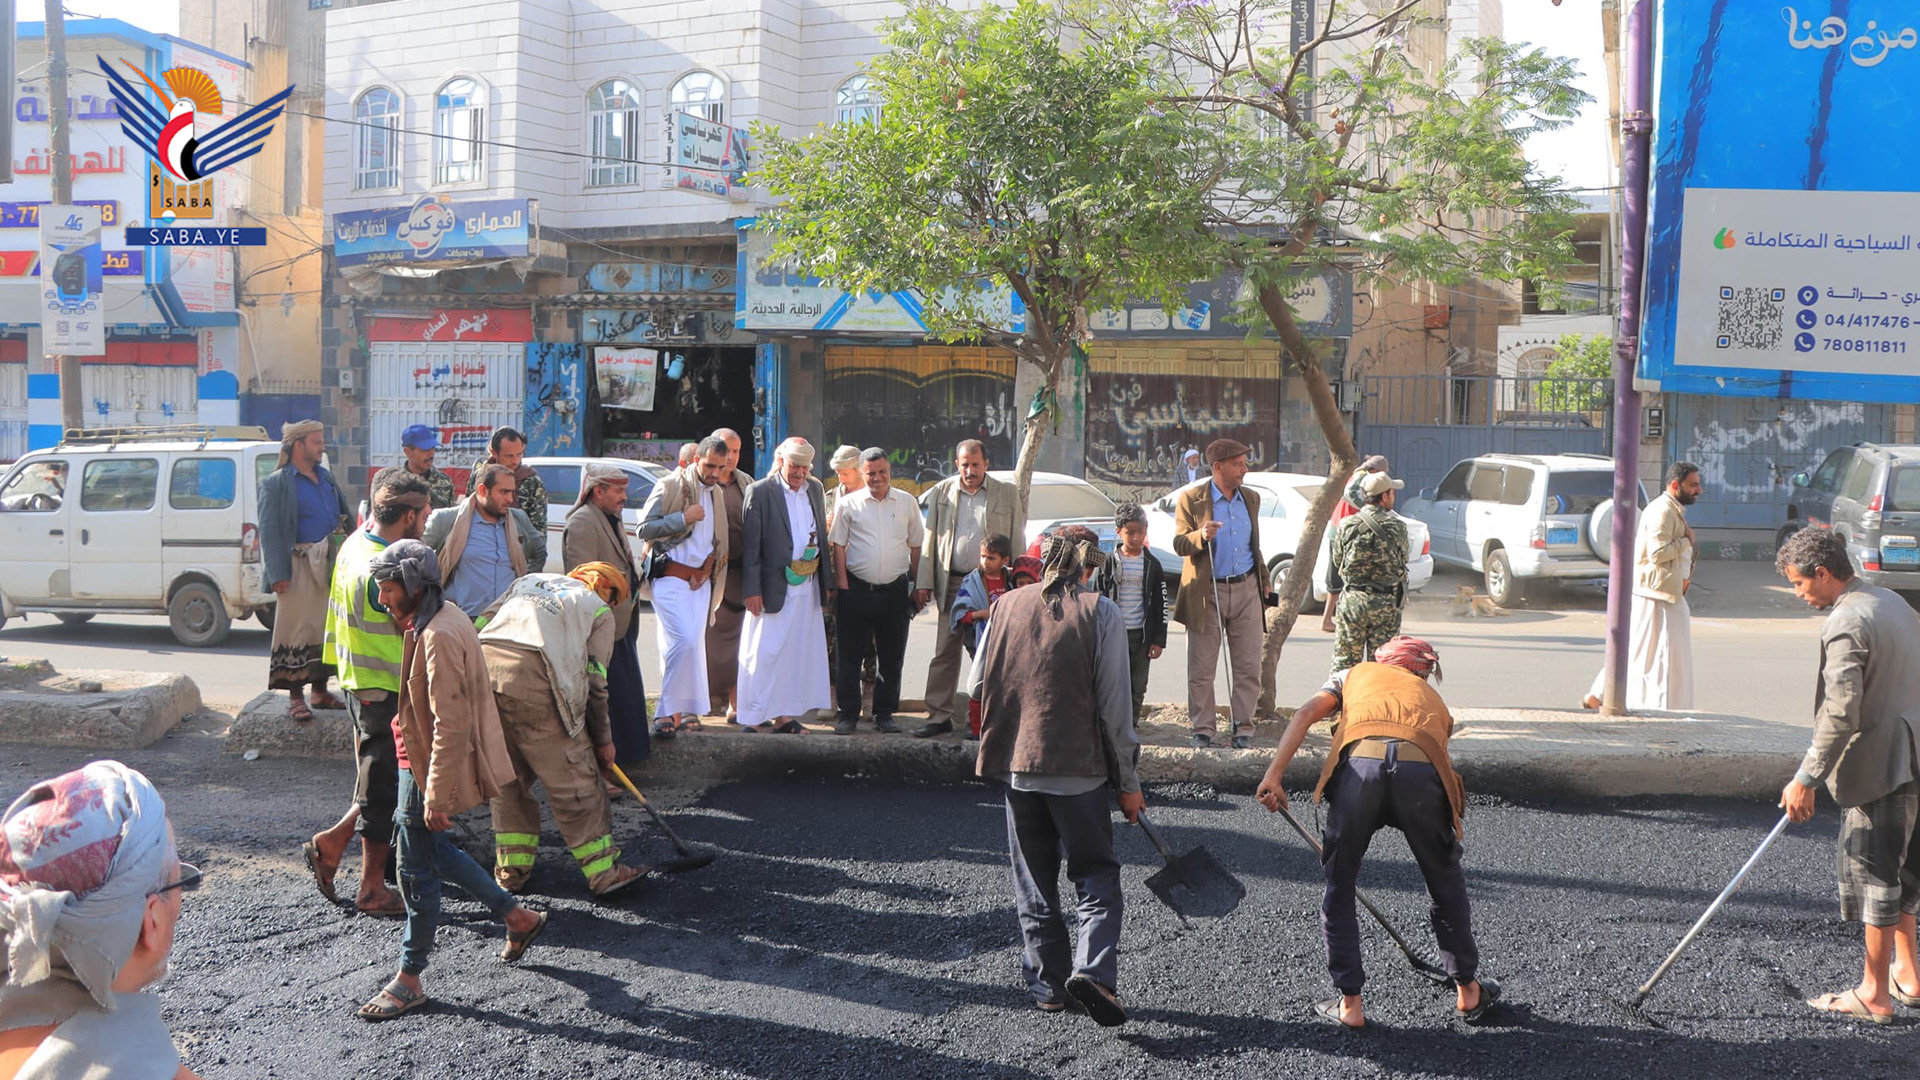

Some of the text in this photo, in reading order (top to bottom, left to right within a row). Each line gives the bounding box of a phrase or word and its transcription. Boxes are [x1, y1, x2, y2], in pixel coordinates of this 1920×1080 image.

[1781, 6, 1918, 67] من هنا
[400, 210, 454, 237] فوكس
[464, 209, 521, 239] العماري
[1744, 230, 1828, 250] المتكاملة
[1834, 233, 1910, 253] السياحية
[751, 300, 822, 317] الرجالية الحديثة
[1823, 338, 1906, 353] 780811811
